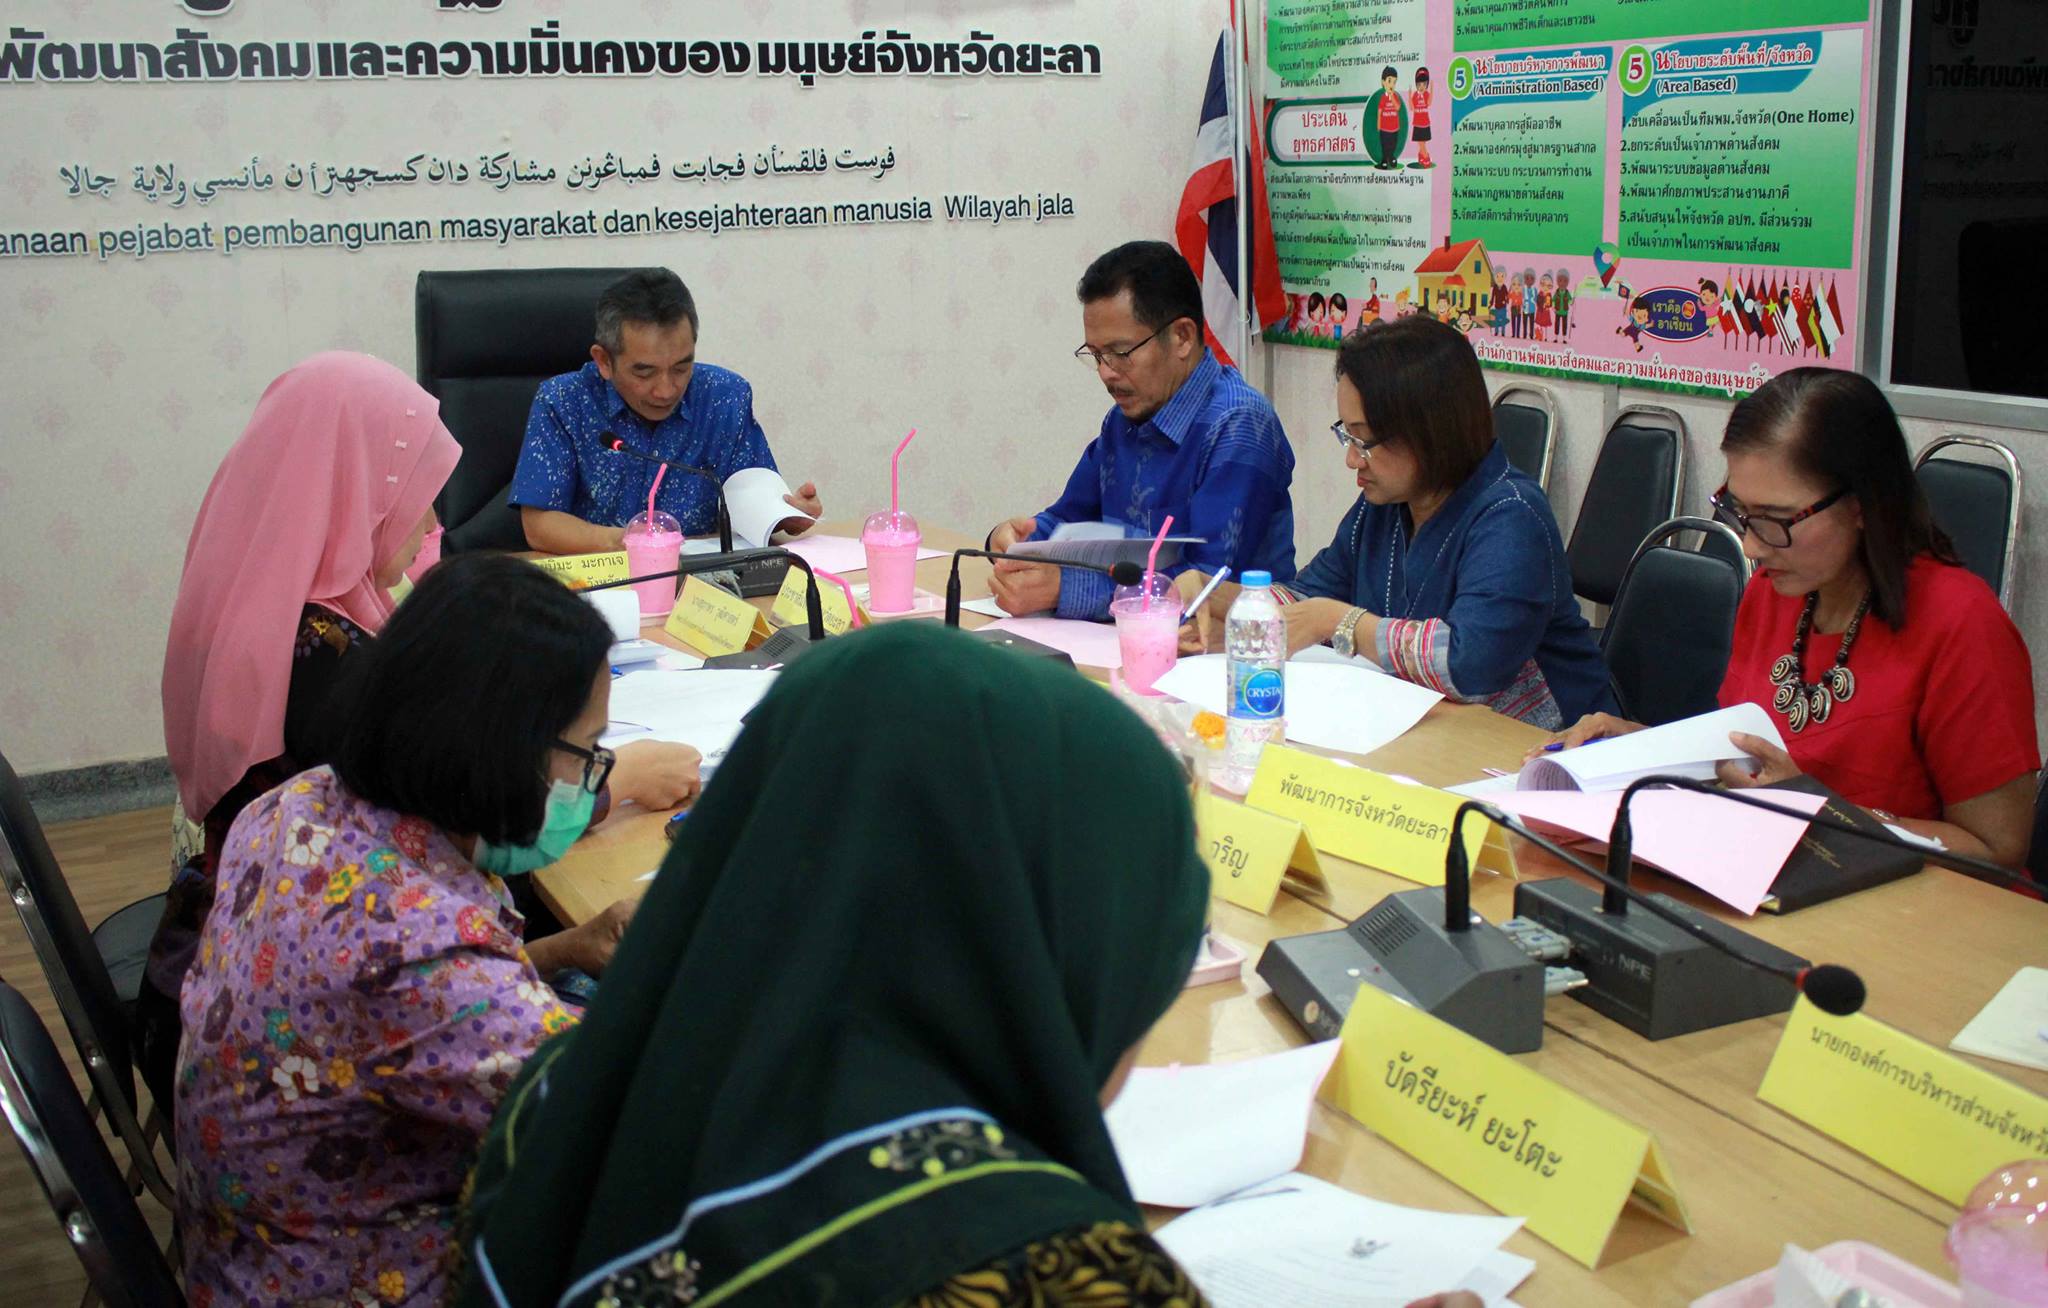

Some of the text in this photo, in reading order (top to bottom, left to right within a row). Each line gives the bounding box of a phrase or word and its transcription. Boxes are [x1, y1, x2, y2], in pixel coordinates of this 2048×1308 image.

[1475, 53, 1605, 74] นโยบายบริหารการพัฒนา
[1629, 57, 1643, 80] 5
[1455, 69, 1466, 88] 5
[1473, 76, 1604, 98] (Administration Based)
[1656, 76, 1738, 96] (Area Based)
[427, 157, 470, 183] دان
[100, 222, 214, 257] pejabat
[224, 219, 431, 252] pembangunan
[440, 210, 597, 245] masyarakat
[603, 209, 651, 233] dan
[654, 203, 827, 234] kesejahteraan
[832, 197, 932, 224] manusia
[945, 193, 1031, 224] Wilayah
[1036, 193, 1075, 220] jala
[1280, 773, 1448, 844] พัฒนาการจังหวัดยะลา
